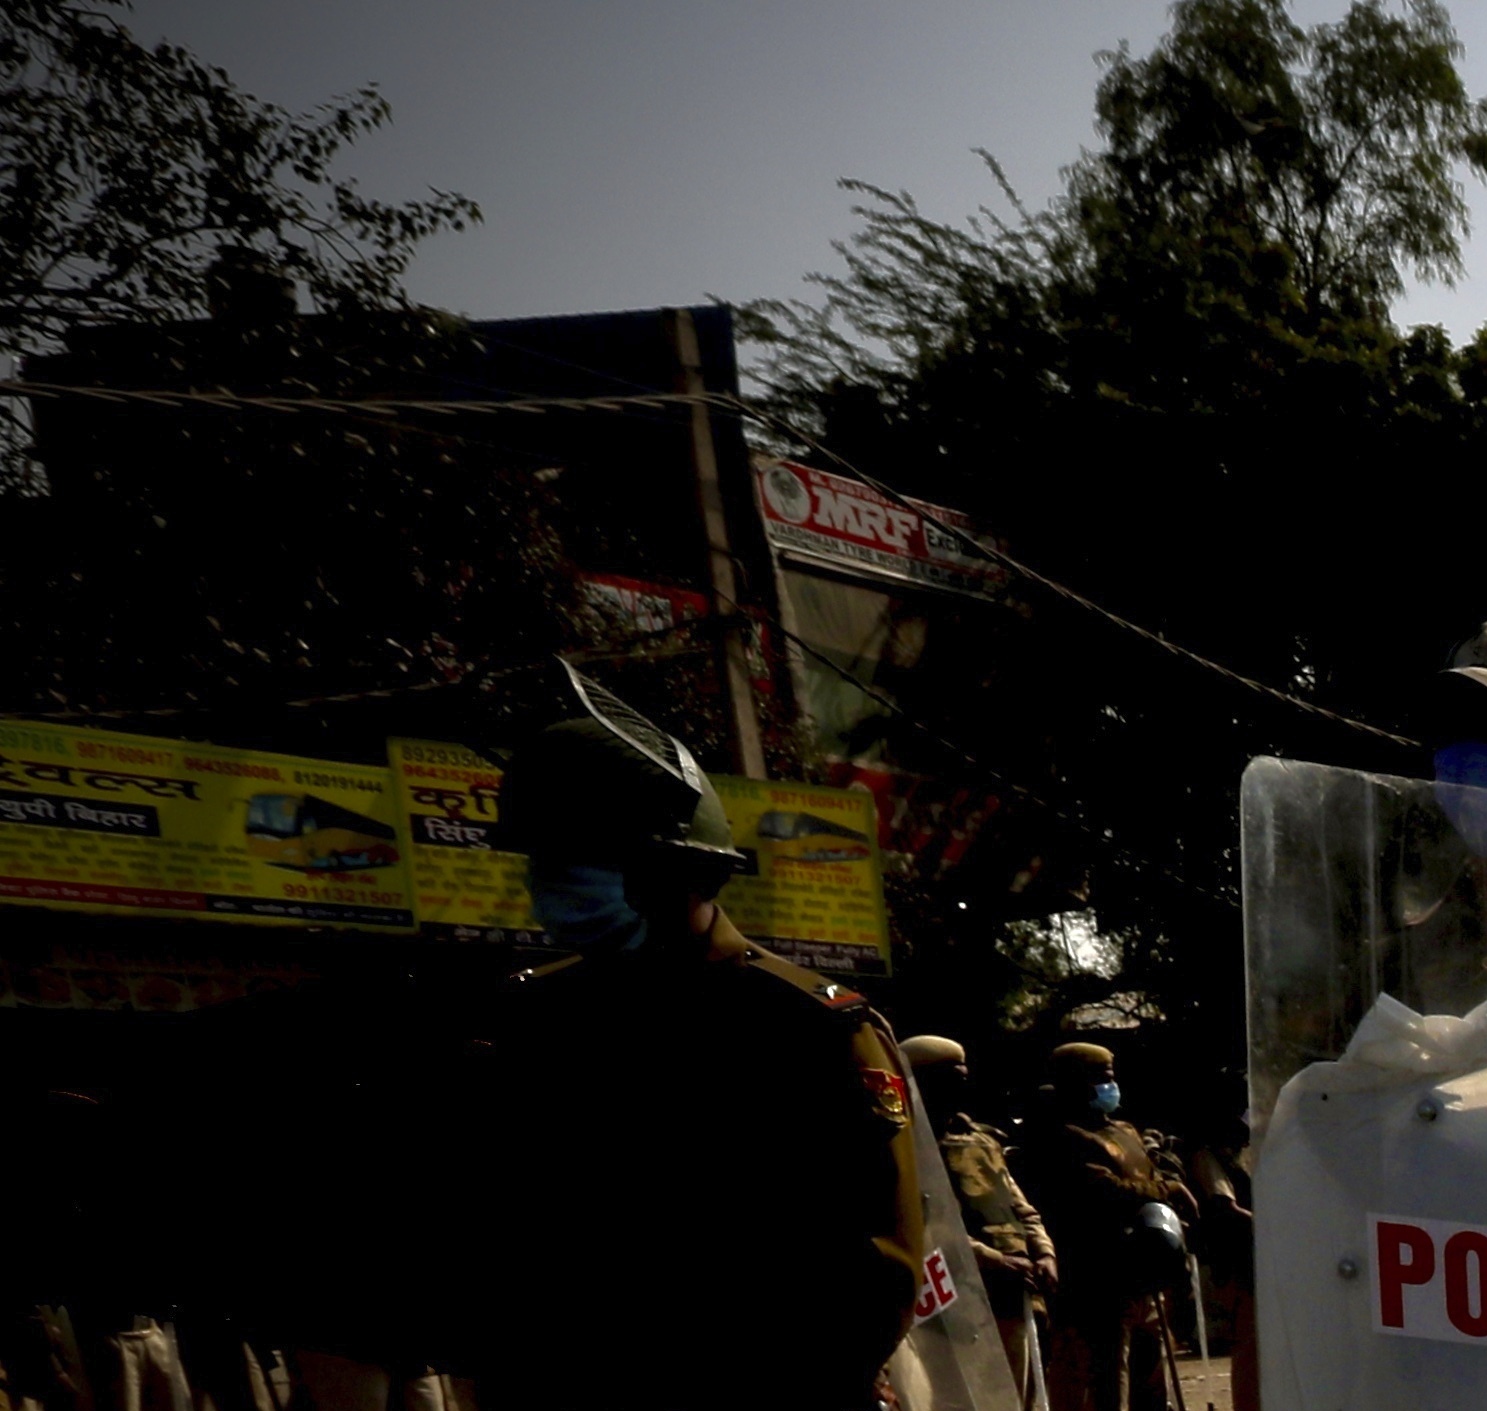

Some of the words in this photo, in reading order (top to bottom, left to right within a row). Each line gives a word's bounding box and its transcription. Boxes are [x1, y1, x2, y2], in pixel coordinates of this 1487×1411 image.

[812, 485, 918, 551] MRF
[771, 522, 838, 549] VARDHMAN
[842, 538, 873, 560] TYRE
[294, 769, 384, 793] 8120191444
[63, 801, 148, 828] बिहार
[282, 883, 404, 906] 9911321507
